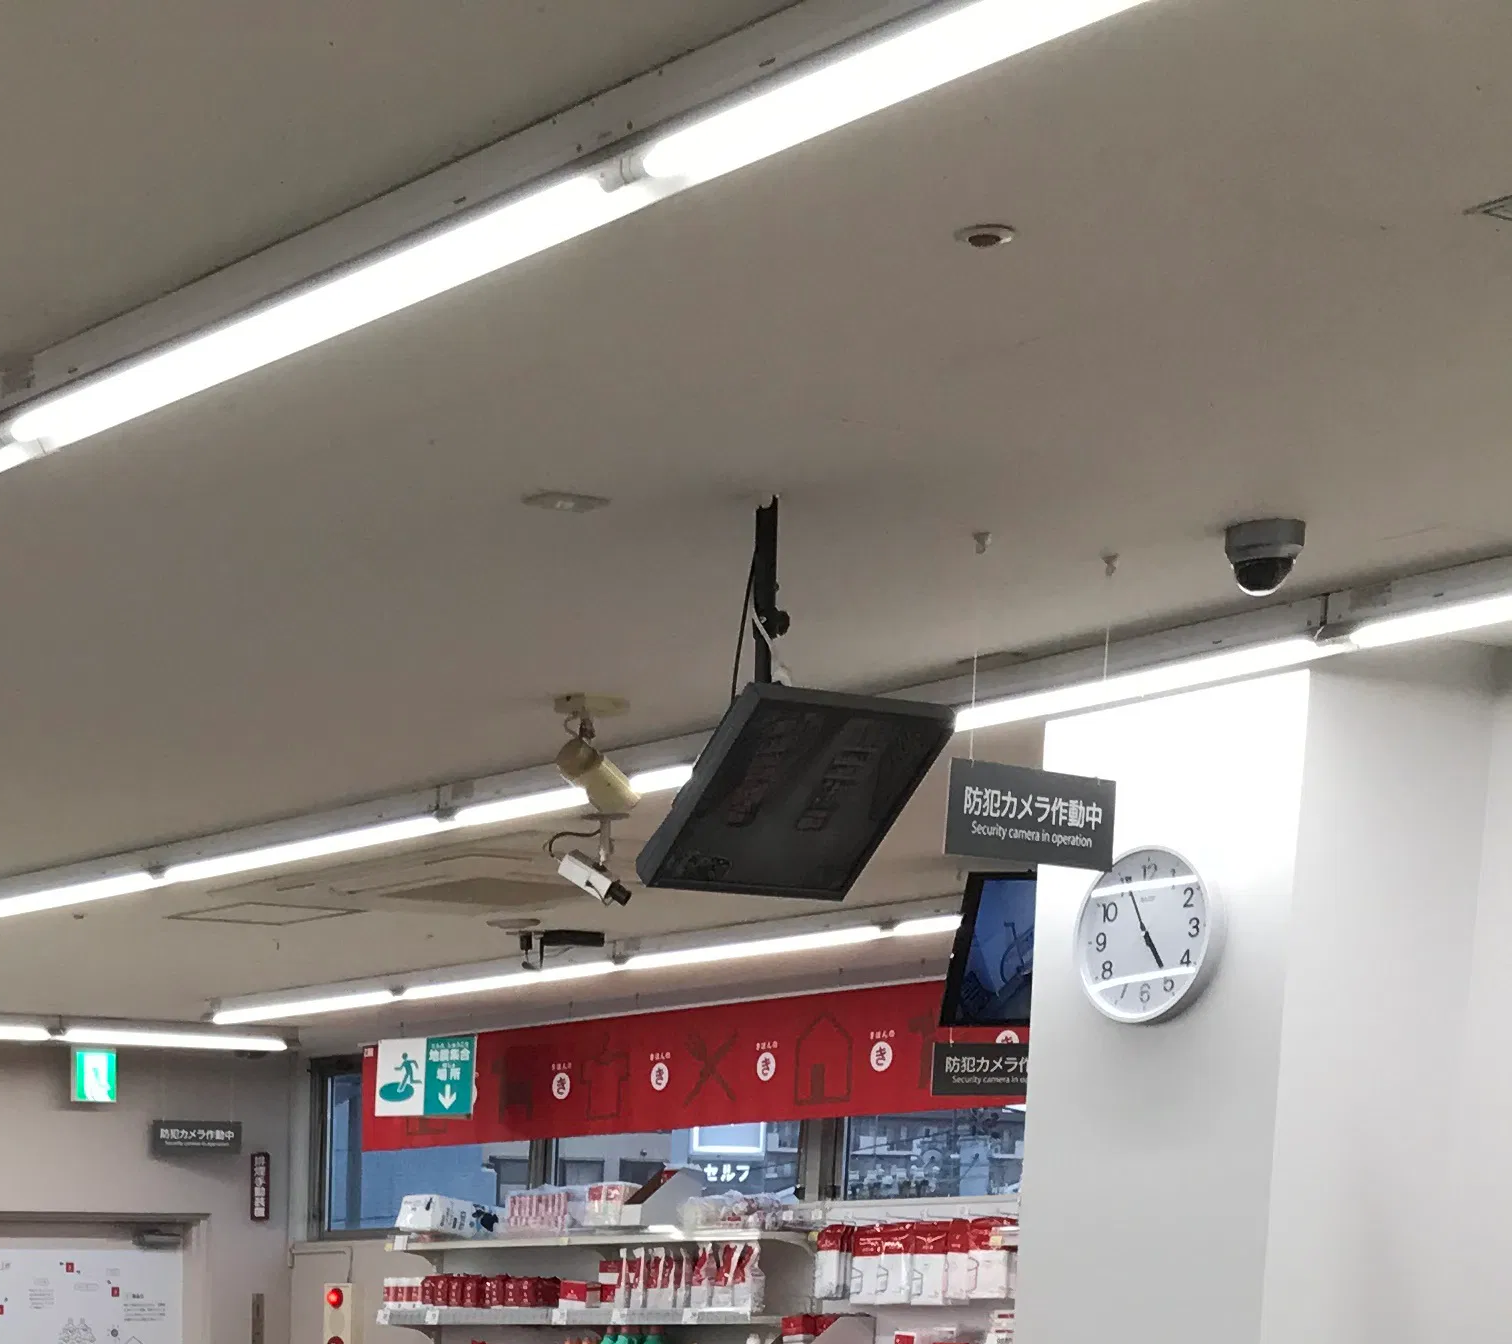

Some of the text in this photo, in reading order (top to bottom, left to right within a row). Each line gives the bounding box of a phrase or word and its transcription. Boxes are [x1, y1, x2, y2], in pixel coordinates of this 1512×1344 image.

[963, 785, 1103, 831] 防犯カメラ作動中
[971, 820, 1093, 848] Security camera in operation
[1182, 887, 1195, 908] 2
[1101, 901, 1118, 923] 10
[1187, 917, 1201, 938] 3
[1095, 932, 1107, 952] 9
[1179, 949, 1192, 966] 4
[1101, 960, 1114, 980] 8
[1162, 976, 1176, 992] 5
[160, 1127, 235, 1142] 防犯カメラ作動中
[703, 1162, 750, 1183] セルフ
